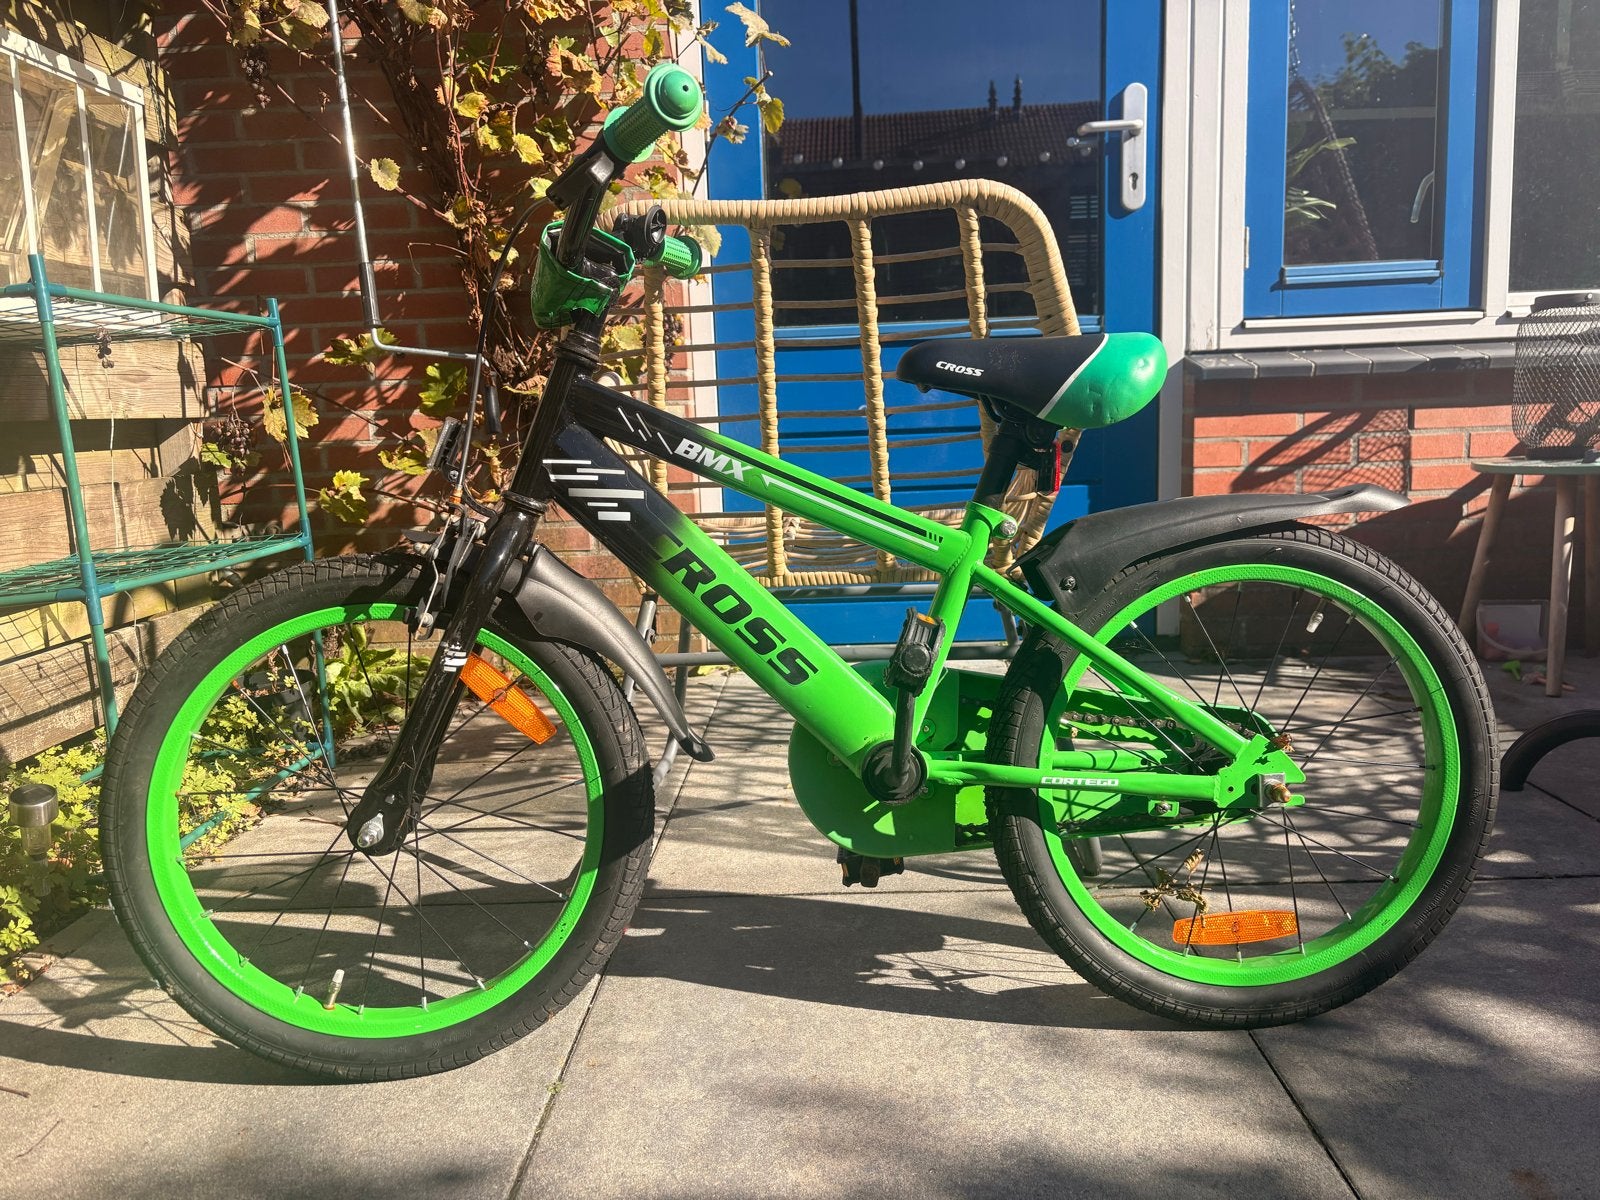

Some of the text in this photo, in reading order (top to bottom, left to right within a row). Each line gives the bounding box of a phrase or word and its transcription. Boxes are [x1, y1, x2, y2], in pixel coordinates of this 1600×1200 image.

[936, 360, 984, 377] CROSS
[674, 438, 754, 482] BMX
[1041, 776, 1119, 787] CORTEGO
